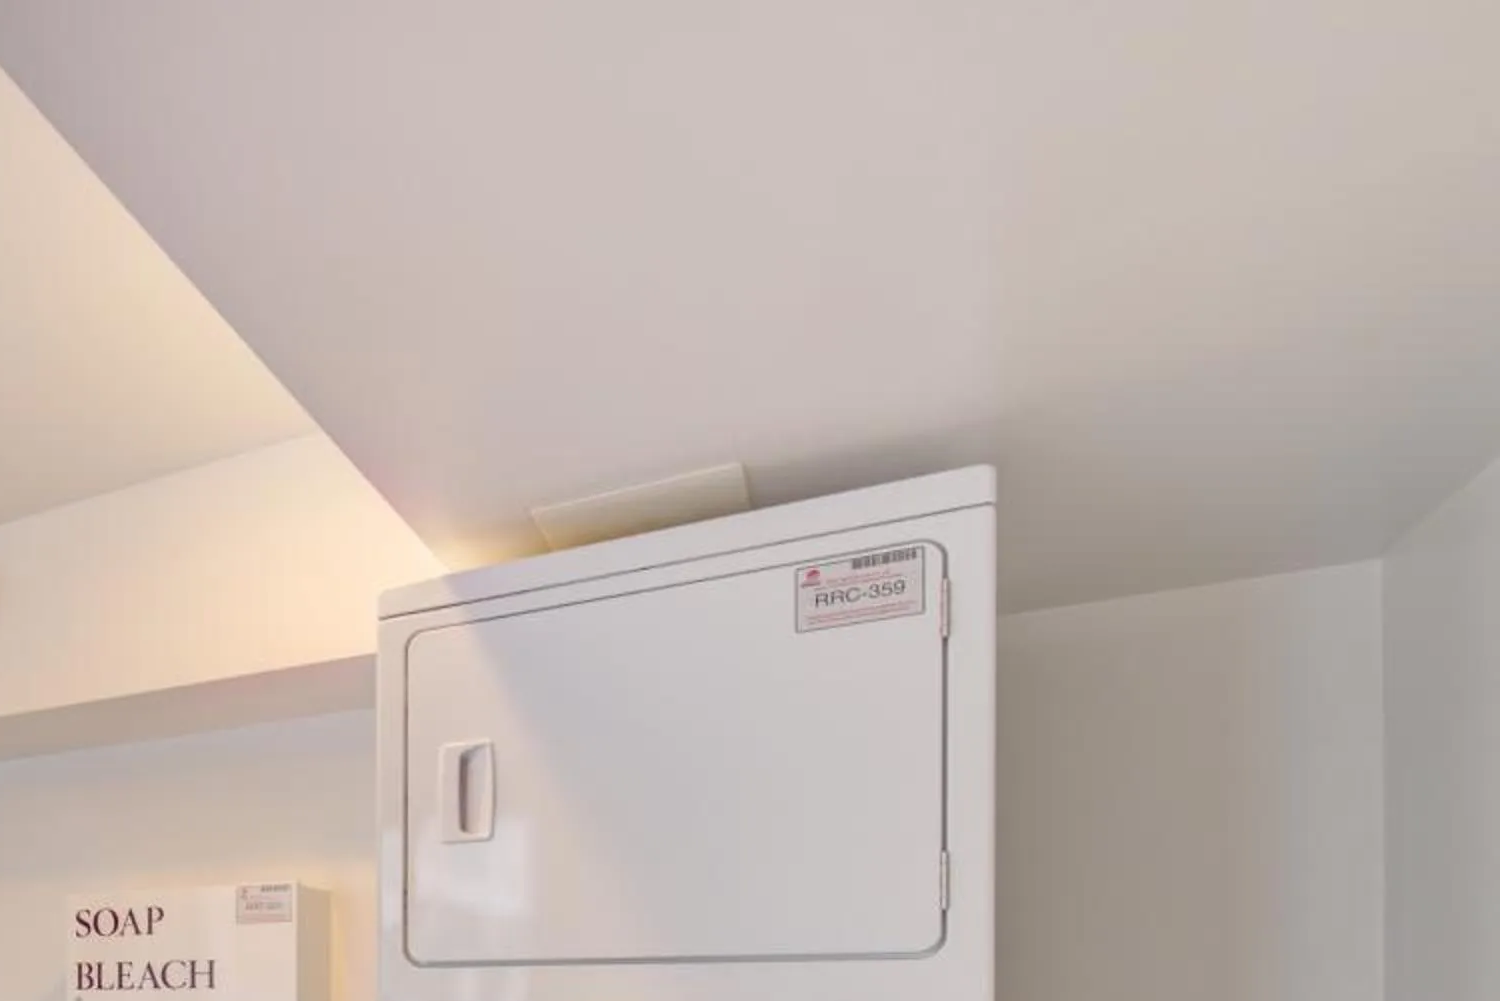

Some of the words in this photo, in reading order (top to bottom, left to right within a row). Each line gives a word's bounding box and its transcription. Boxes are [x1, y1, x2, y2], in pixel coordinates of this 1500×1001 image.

[814, 579, 907, 608] RRC-359
[75, 905, 165, 938] SOAP
[75, 959, 216, 991] BLEACH
